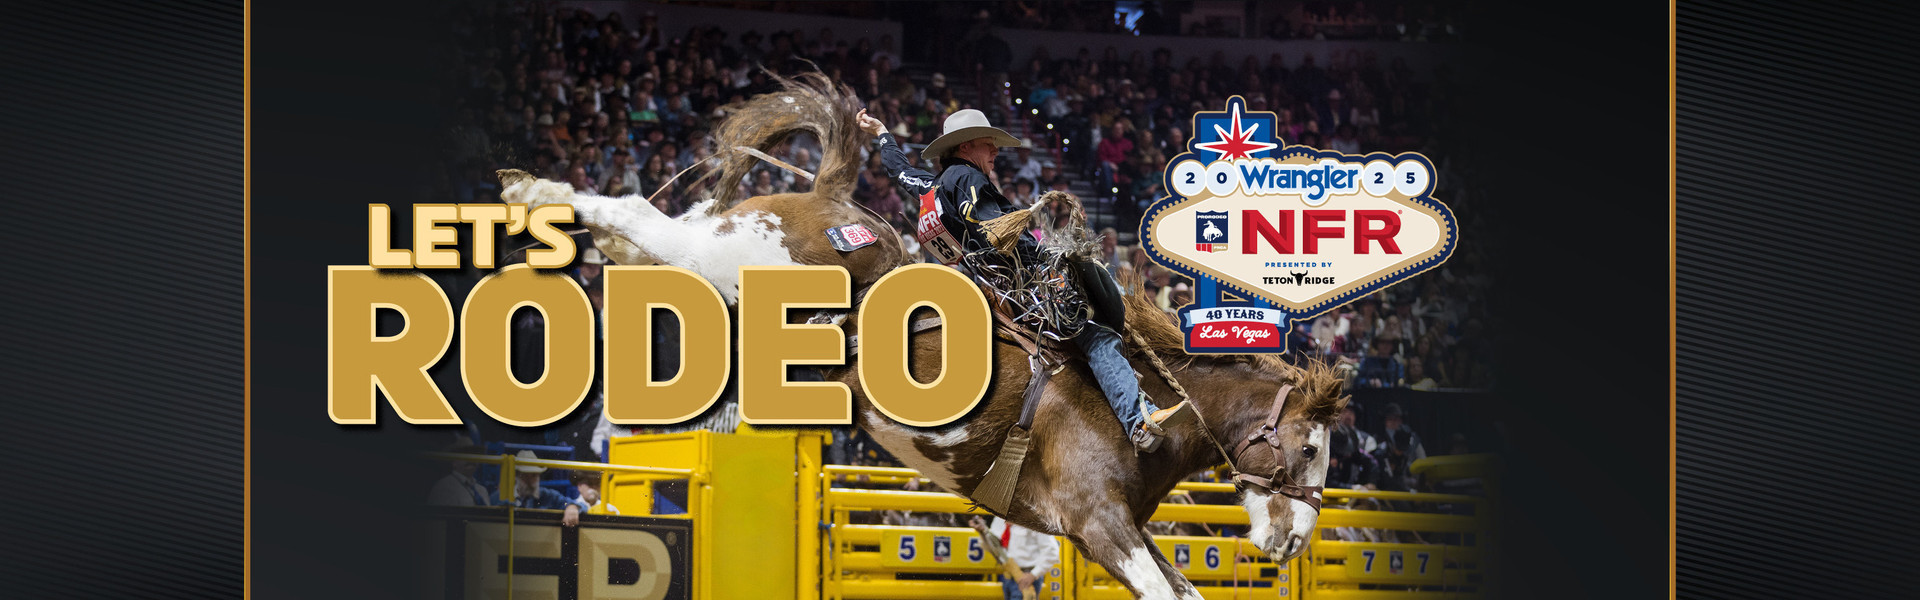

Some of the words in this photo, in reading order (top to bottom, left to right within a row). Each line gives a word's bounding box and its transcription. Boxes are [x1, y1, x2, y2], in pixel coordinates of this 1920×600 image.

[899, 535, 916, 562] 5
[968, 536, 984, 562] 5
[1205, 545, 1220, 570] 6
[1362, 550, 1376, 574] 7
[1417, 552, 1430, 575] 7
